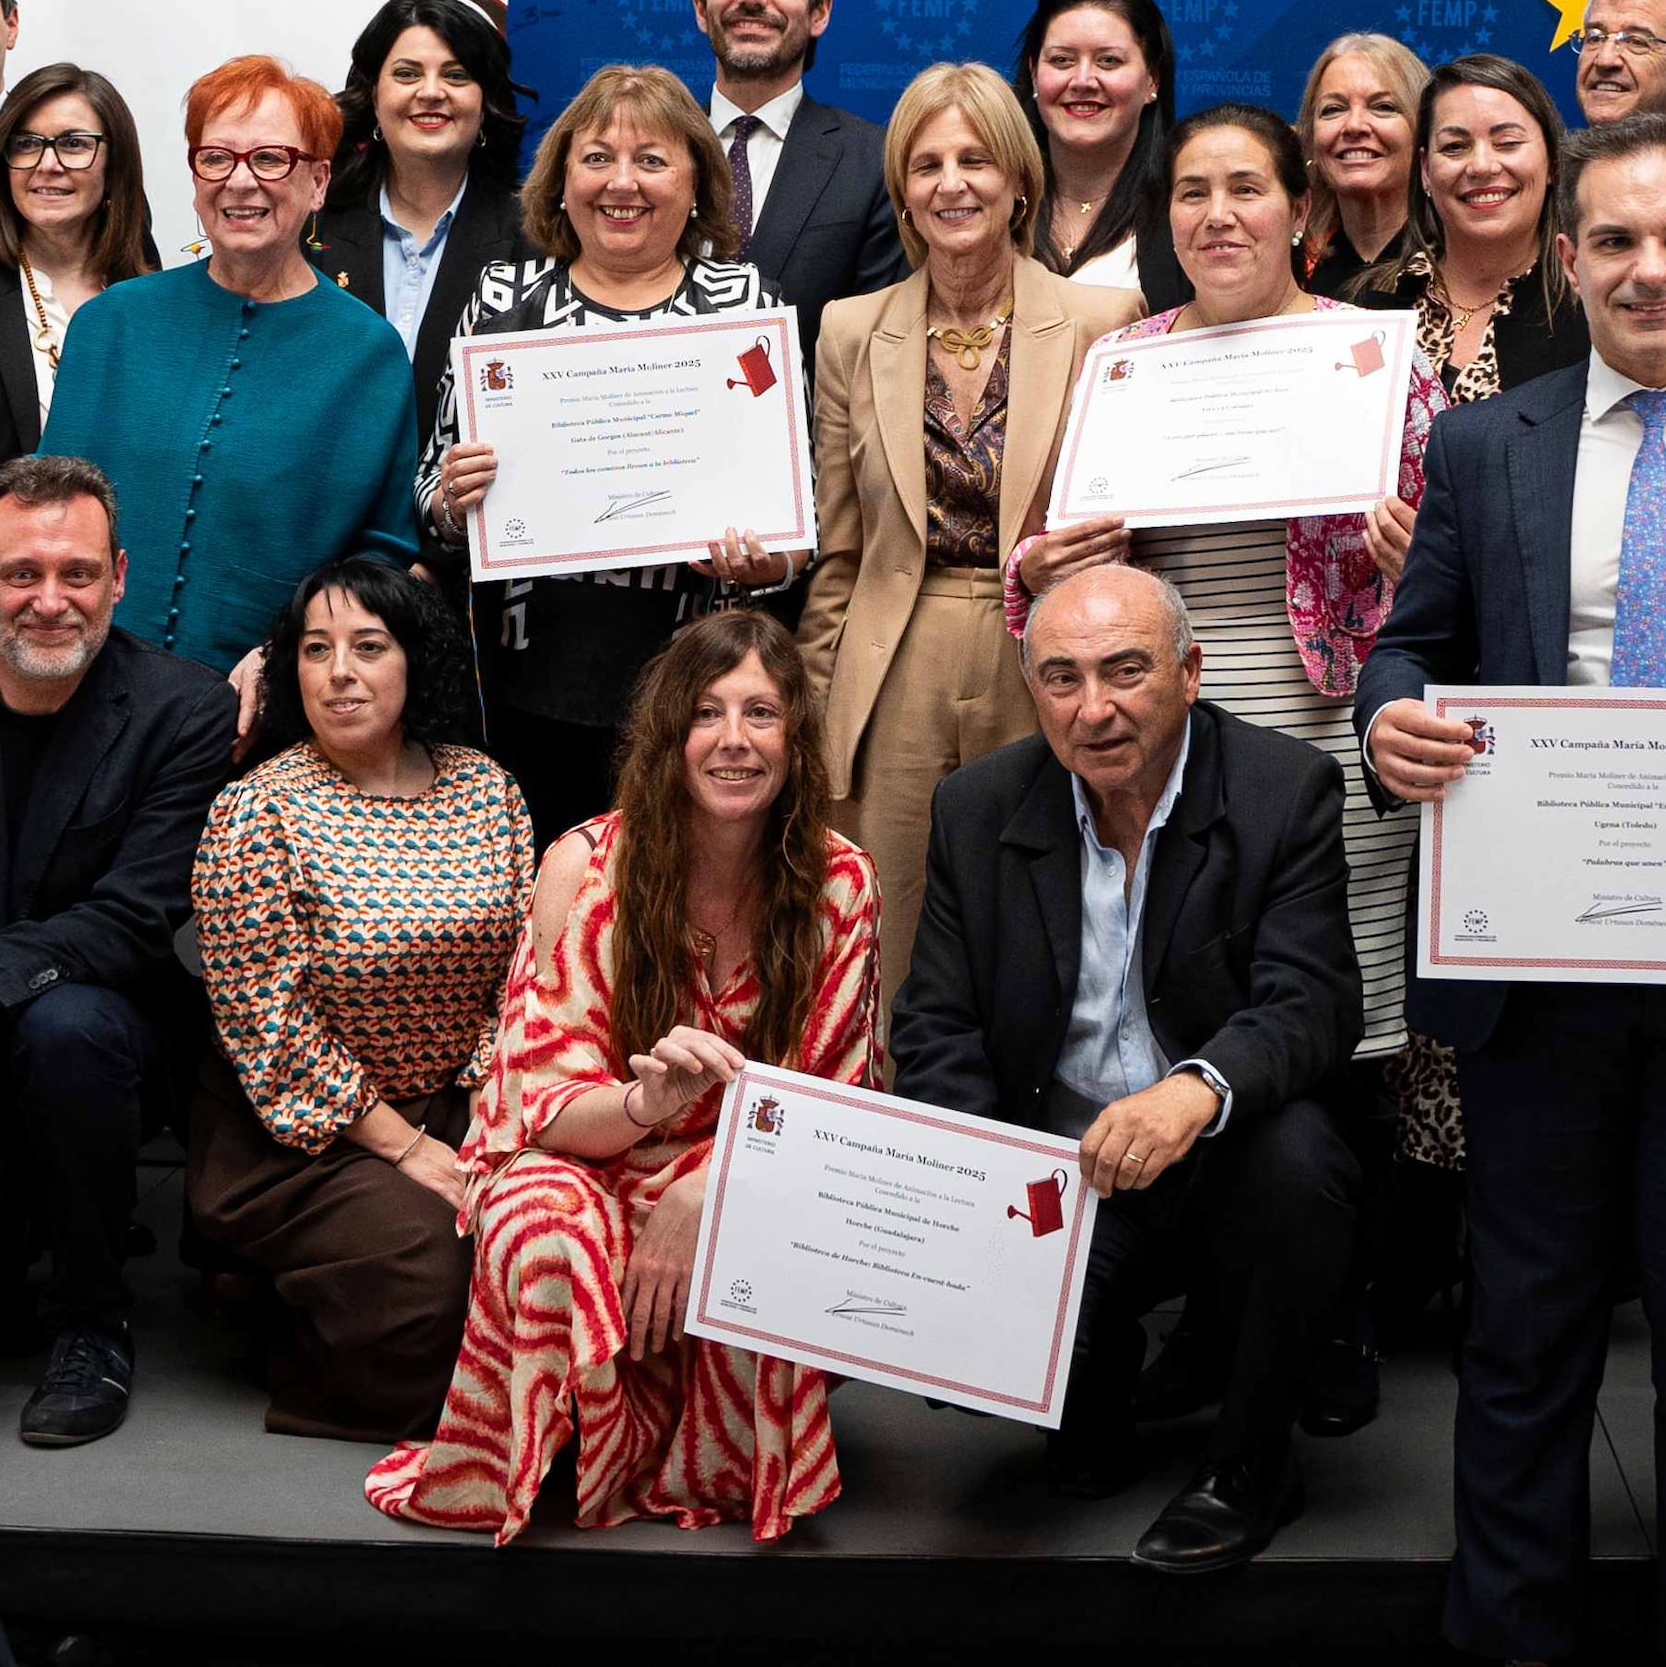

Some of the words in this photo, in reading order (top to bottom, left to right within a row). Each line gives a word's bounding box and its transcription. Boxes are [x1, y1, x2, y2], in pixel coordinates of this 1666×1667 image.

[1418, 0, 1476, 27] FEMP
[1183, 69, 1248, 85] ESPAÑOLA
[1252, 71, 1272, 86] DE
[1194, 82, 1273, 98] PROVINCIAS
[541, 370, 565, 381] XXV
[566, 367, 606, 379] Campaña
[608, 364, 635, 374] María
[637, 360, 672, 371] Moliner
[673, 359, 700, 369] 2025
[1530, 738, 1557, 748] XXV
[1560, 739, 1609, 750] Campaña
[1613, 739, 1644, 750] María
[1612, 801, 1652, 810] Municipal
[1622, 821, 1656, 829] (Toledo)
[1621, 840, 1651, 849] proyecto
[1592, 893, 1623, 901] Ministro
[1634, 894, 1660, 902] Cultura
[812, 1129, 838, 1143] XXV
[838, 1136, 883, 1155] Campaña
[885, 1147, 914, 1162] María
[916, 1154, 955, 1172] Moliner
[955, 1165, 986, 1182] 2025
[817, 1191, 854, 1206] Biblioteca
[855, 1200, 882, 1213] Pública
[883, 1207, 921, 1224] Municipal
[922, 1217, 931, 1225] de
[932, 1220, 959, 1232] Horche
[845, 1217, 872, 1230] Horche
[873, 1224, 925, 1245] (Guadalajara)
